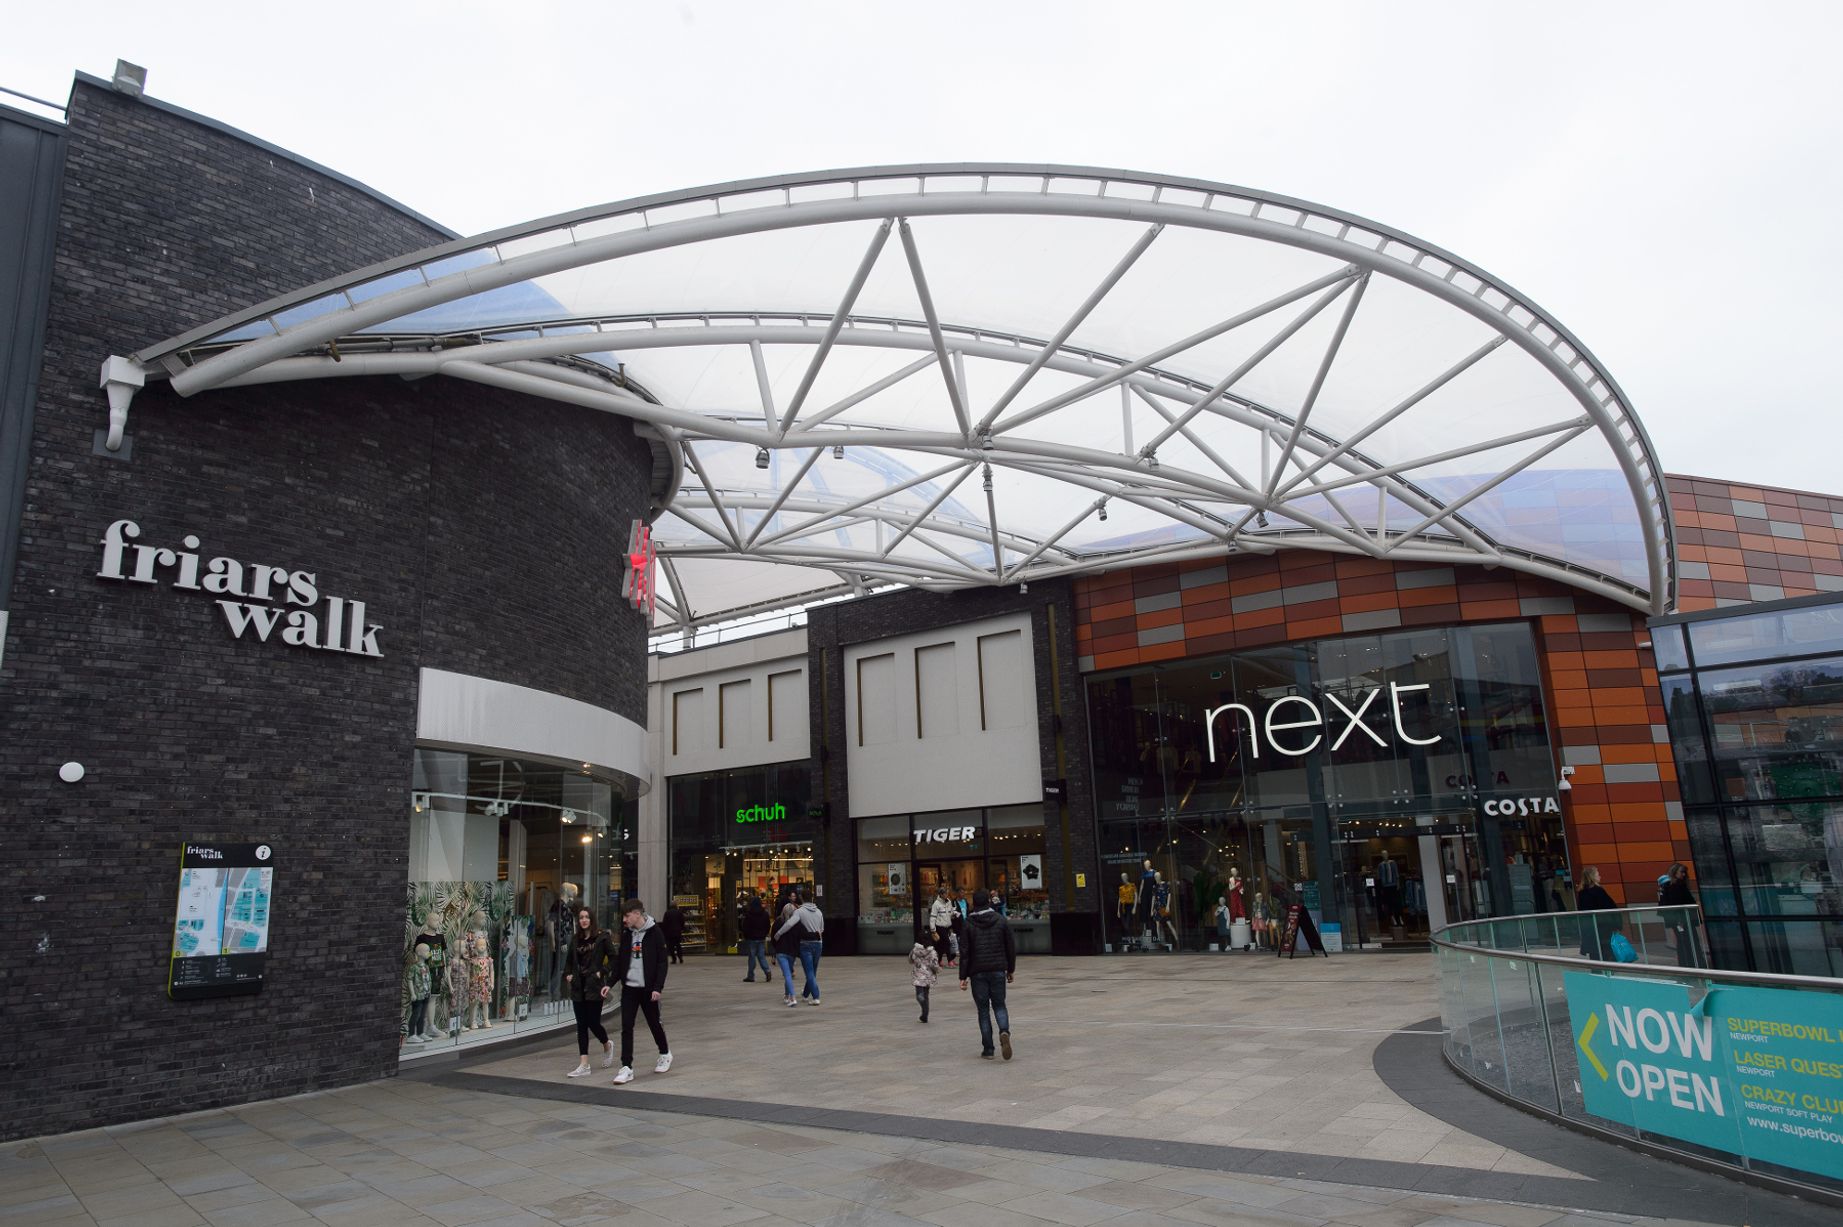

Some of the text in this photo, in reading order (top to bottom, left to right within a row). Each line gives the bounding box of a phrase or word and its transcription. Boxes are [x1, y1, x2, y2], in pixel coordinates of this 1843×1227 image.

[96, 519, 318, 607] friars
[215, 595, 385, 658] walk
[1205, 681, 1442, 763] next
[1445, 771, 1510, 788] COA
[736, 803, 785, 823] schuh
[1484, 797, 1560, 817] COSTA
[913, 826, 976, 843] TIGER
[187, 845, 214, 855] friars
[200, 851, 223, 859] walk
[1605, 1004, 1712, 1061] NOW
[1727, 1017, 1836, 1043] SUPERBOWL
[1730, 1032, 1768, 1043] NEWPORT
[1733, 1049, 1787, 1071] LASER
[1736, 1065, 1775, 1078] NEWPORT
[1616, 1060, 1725, 1117] OPEN
[1741, 1084, 1796, 1106] CRAZY
[1744, 1101, 1832, 1123] NEWPORT SOFT PLAY
